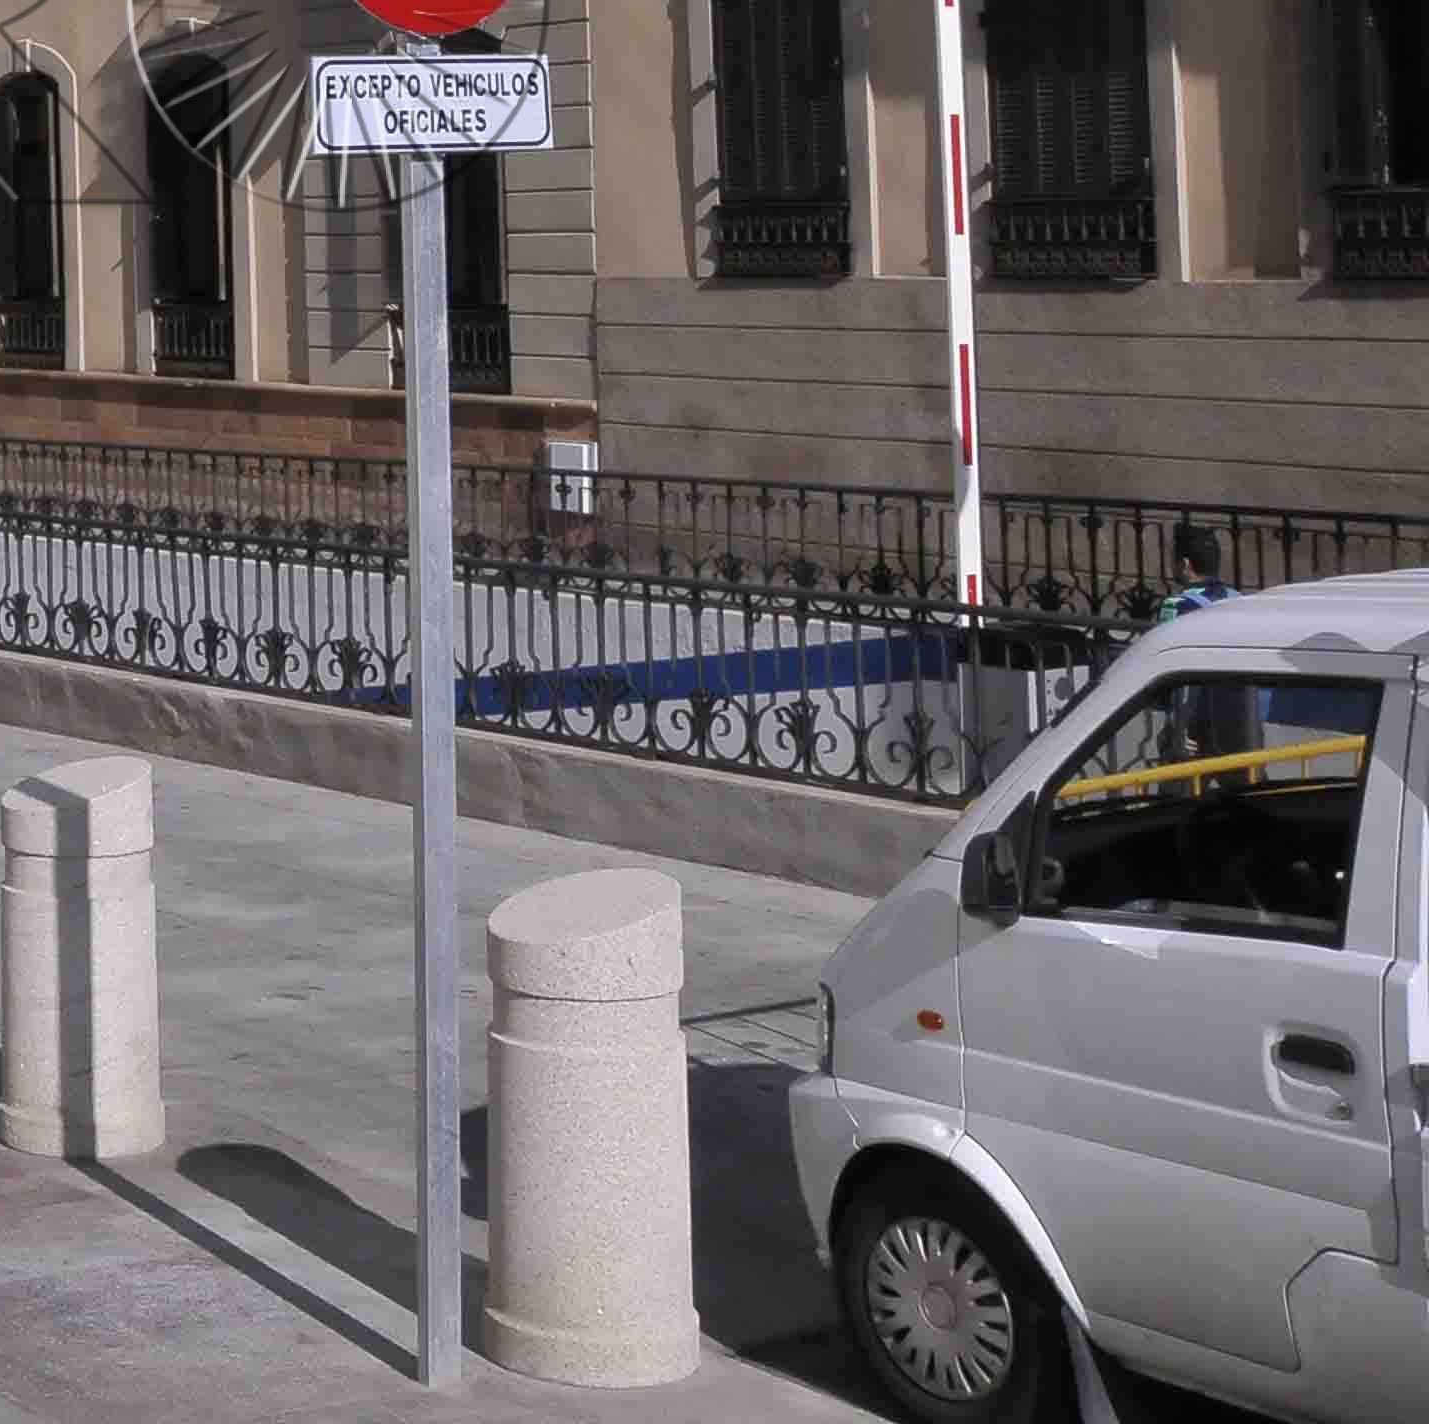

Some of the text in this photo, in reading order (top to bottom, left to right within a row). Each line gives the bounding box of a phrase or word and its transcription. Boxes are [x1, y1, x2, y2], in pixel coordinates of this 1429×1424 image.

[326, 72, 539, 99] EXCEPTO VEHICULOS
[383, 108, 487, 134] OFICIALES
